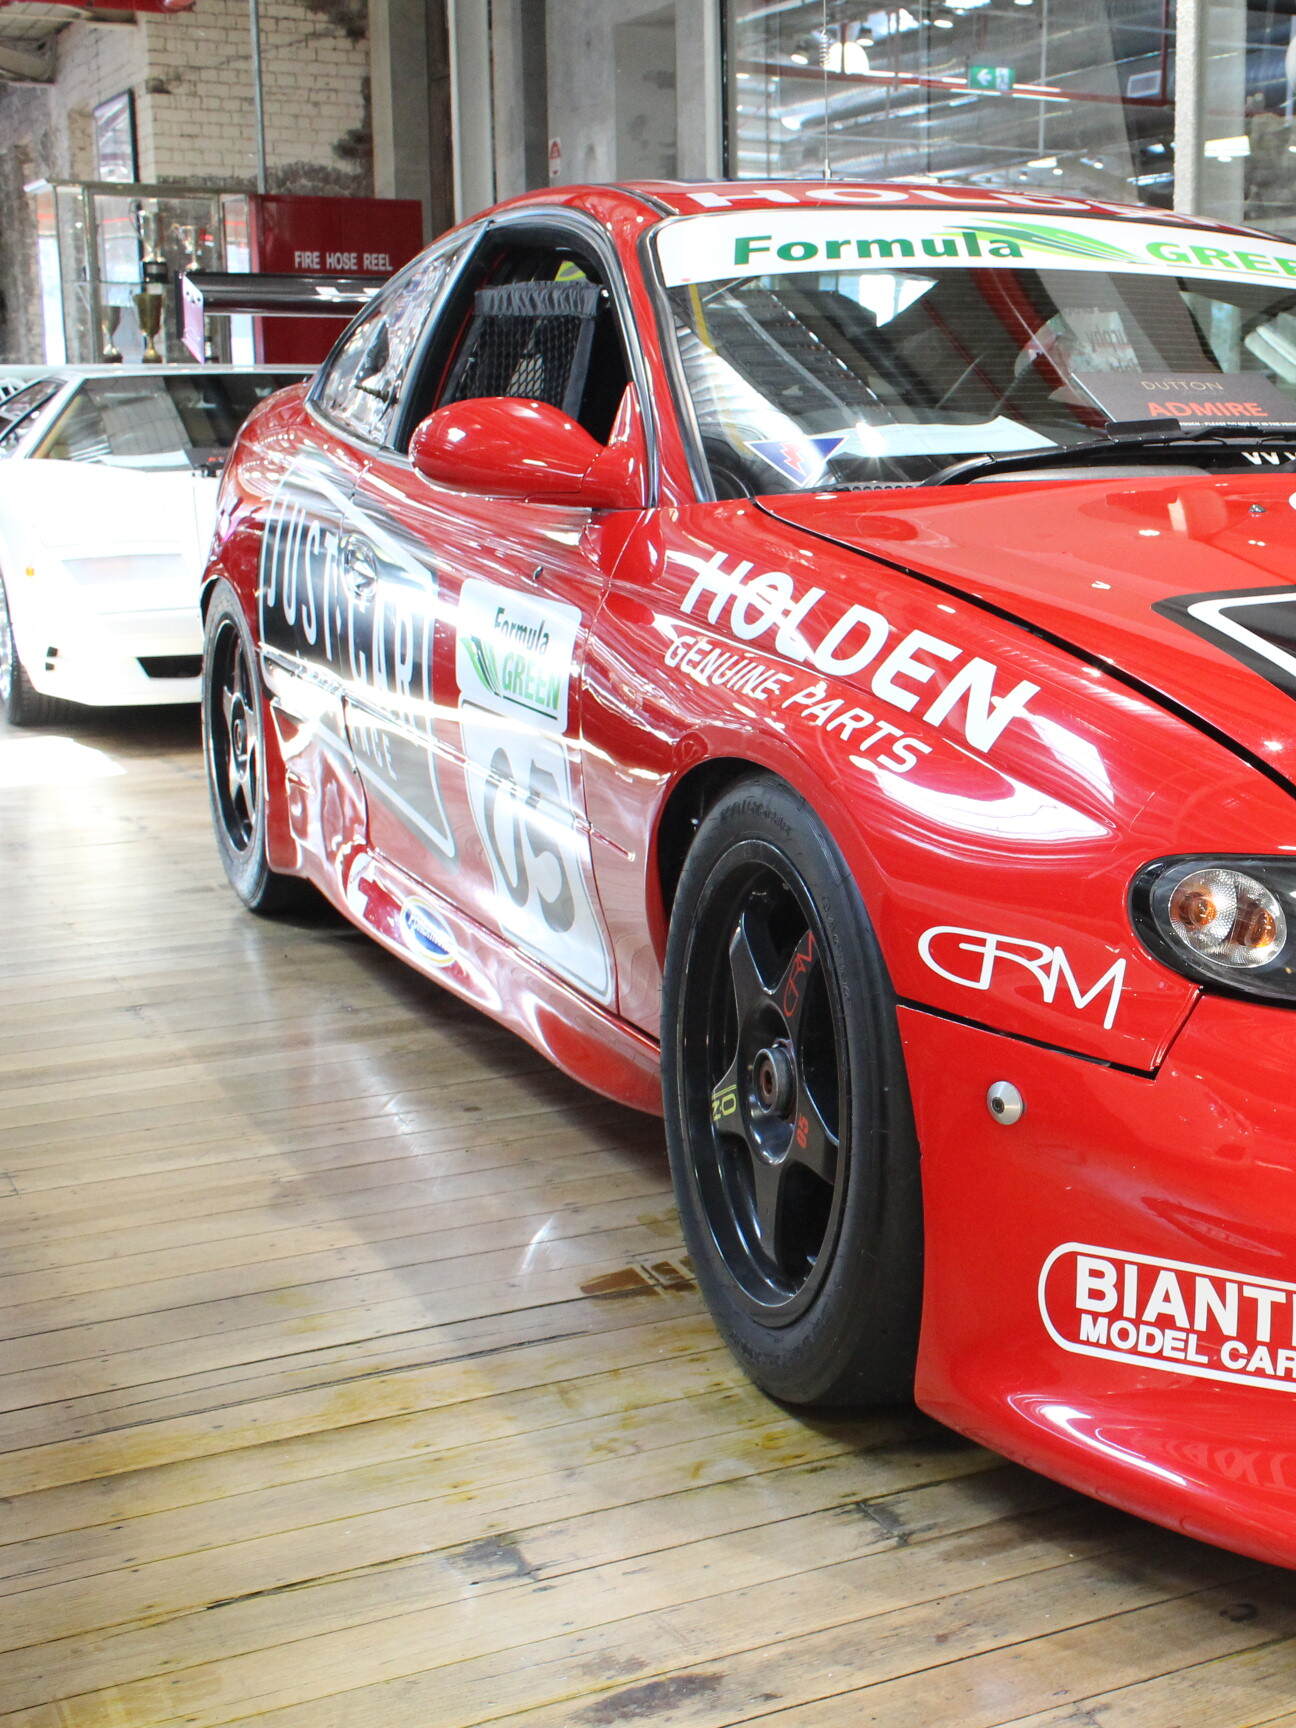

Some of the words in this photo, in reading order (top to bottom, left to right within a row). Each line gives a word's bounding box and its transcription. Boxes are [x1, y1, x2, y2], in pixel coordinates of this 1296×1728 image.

[294, 251, 320, 269] FIRE
[326, 252, 357, 270] HOSE
[363, 253, 393, 271] REEL
[734, 231, 1024, 266] Formula
[1140, 380, 1223, 391] DUTTON
[1147, 402, 1269, 417] ADMIRE
[494, 606, 550, 655] Formula
[680, 551, 1041, 753] HOLDEN
[502, 650, 561, 710] GREEN
[664, 635, 794, 700] GENUINE
[781, 681, 933, 773] PARTS
[484, 747, 575, 933] 05
[918, 925, 1127, 1030] GRM
[1079, 1313, 1209, 1365] MODEL
